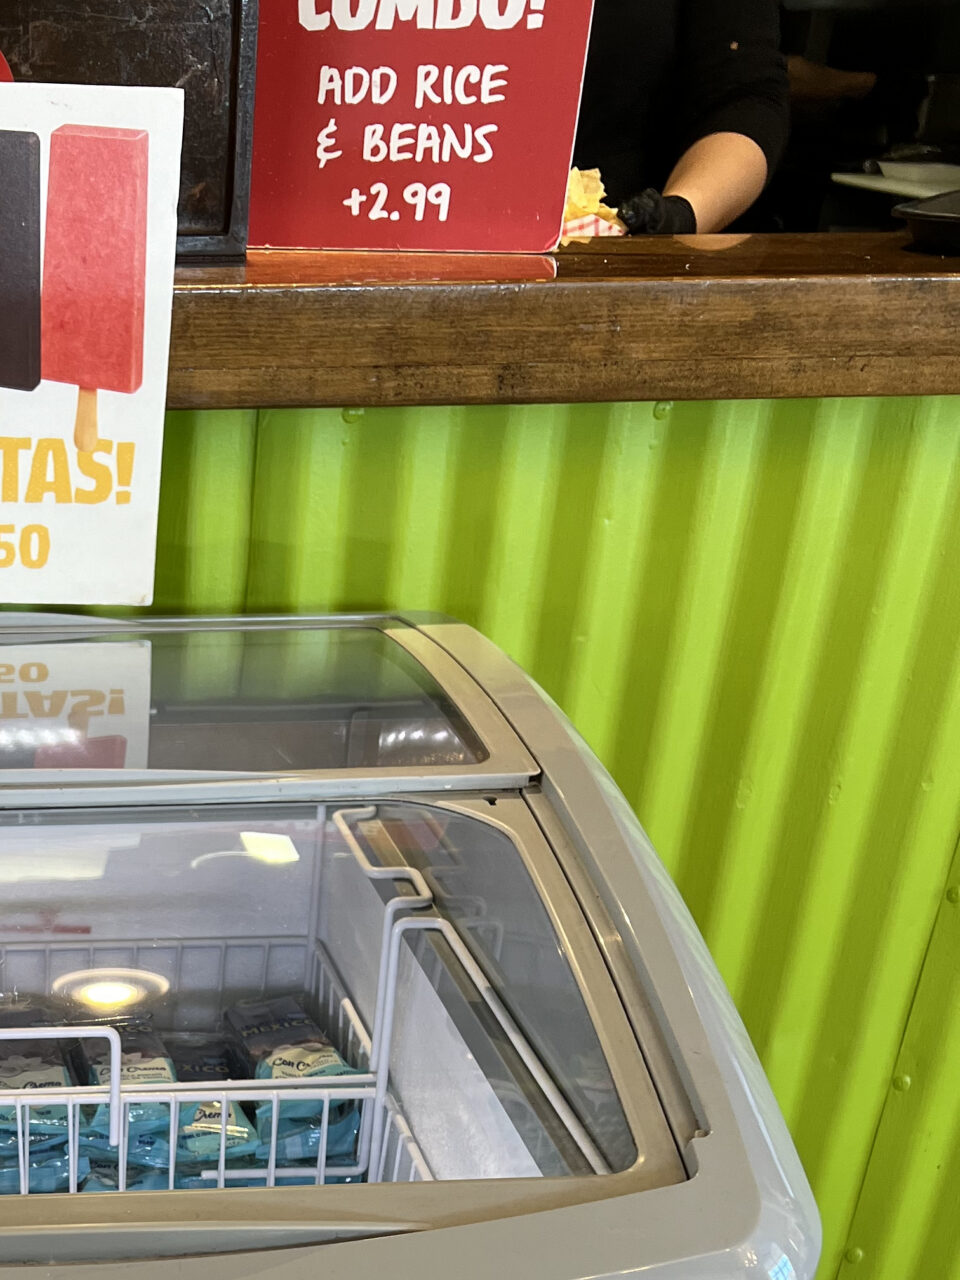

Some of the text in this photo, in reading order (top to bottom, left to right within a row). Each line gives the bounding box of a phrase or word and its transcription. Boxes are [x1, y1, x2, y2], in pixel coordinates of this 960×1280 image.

[317, 64, 509, 109] ADD RICE
[316, 118, 499, 169] & BEANS
[342, 181, 451, 223] +2.99
